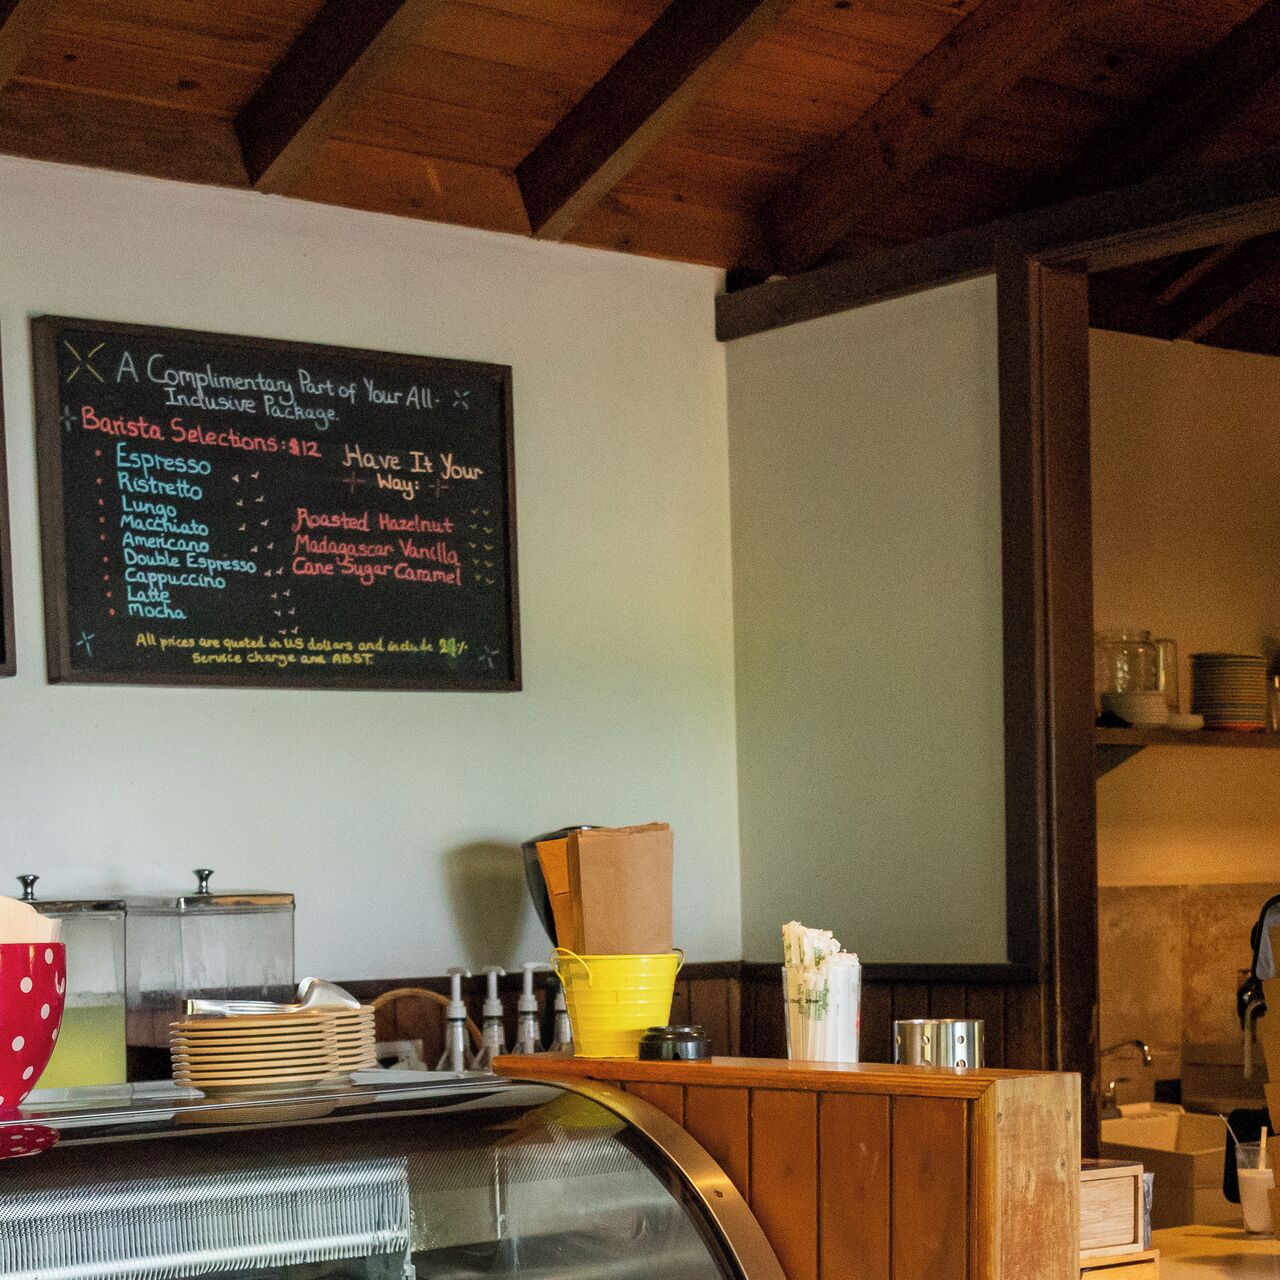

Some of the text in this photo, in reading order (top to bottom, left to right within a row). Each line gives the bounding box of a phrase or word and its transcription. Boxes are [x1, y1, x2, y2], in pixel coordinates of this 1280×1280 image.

[117, 351, 139, 383] A
[147, 353, 295, 405] Complimentary
[298, 368, 334, 397] Part
[338, 382, 358, 404] of
[362, 377, 403, 405] Your
[164, 387, 257, 413] Inclusive
[81, 405, 165, 441] Barista
[116, 442, 212, 479] Espresso
[342, 444, 484, 480] Have It Your
[117, 471, 203, 500] Ristretto
[376, 473, 420, 500] Way:
[121, 495, 177, 521] Lungo
[291, 507, 455, 533] Roasted Hazelnut
[120, 514, 209, 536] Macchiato
[122, 532, 210, 553] Americano
[293, 534, 459, 565] Madagascar Vanilla
[124, 548, 257, 577] Double Espresso
[292, 556, 461, 586] Cane Sugar Caramel
[124, 567, 227, 590] Cappuccino
[127, 585, 171, 603] Latte
[136, 632, 156, 647] All
[160, 635, 195, 651] prices
[199, 638, 220, 648] are
[223, 635, 267, 651] quoted
[269, 638, 282, 648] in
[307, 637, 354, 651] dollars
[358, 635, 385, 651] and
[387, 637, 433, 652] include
